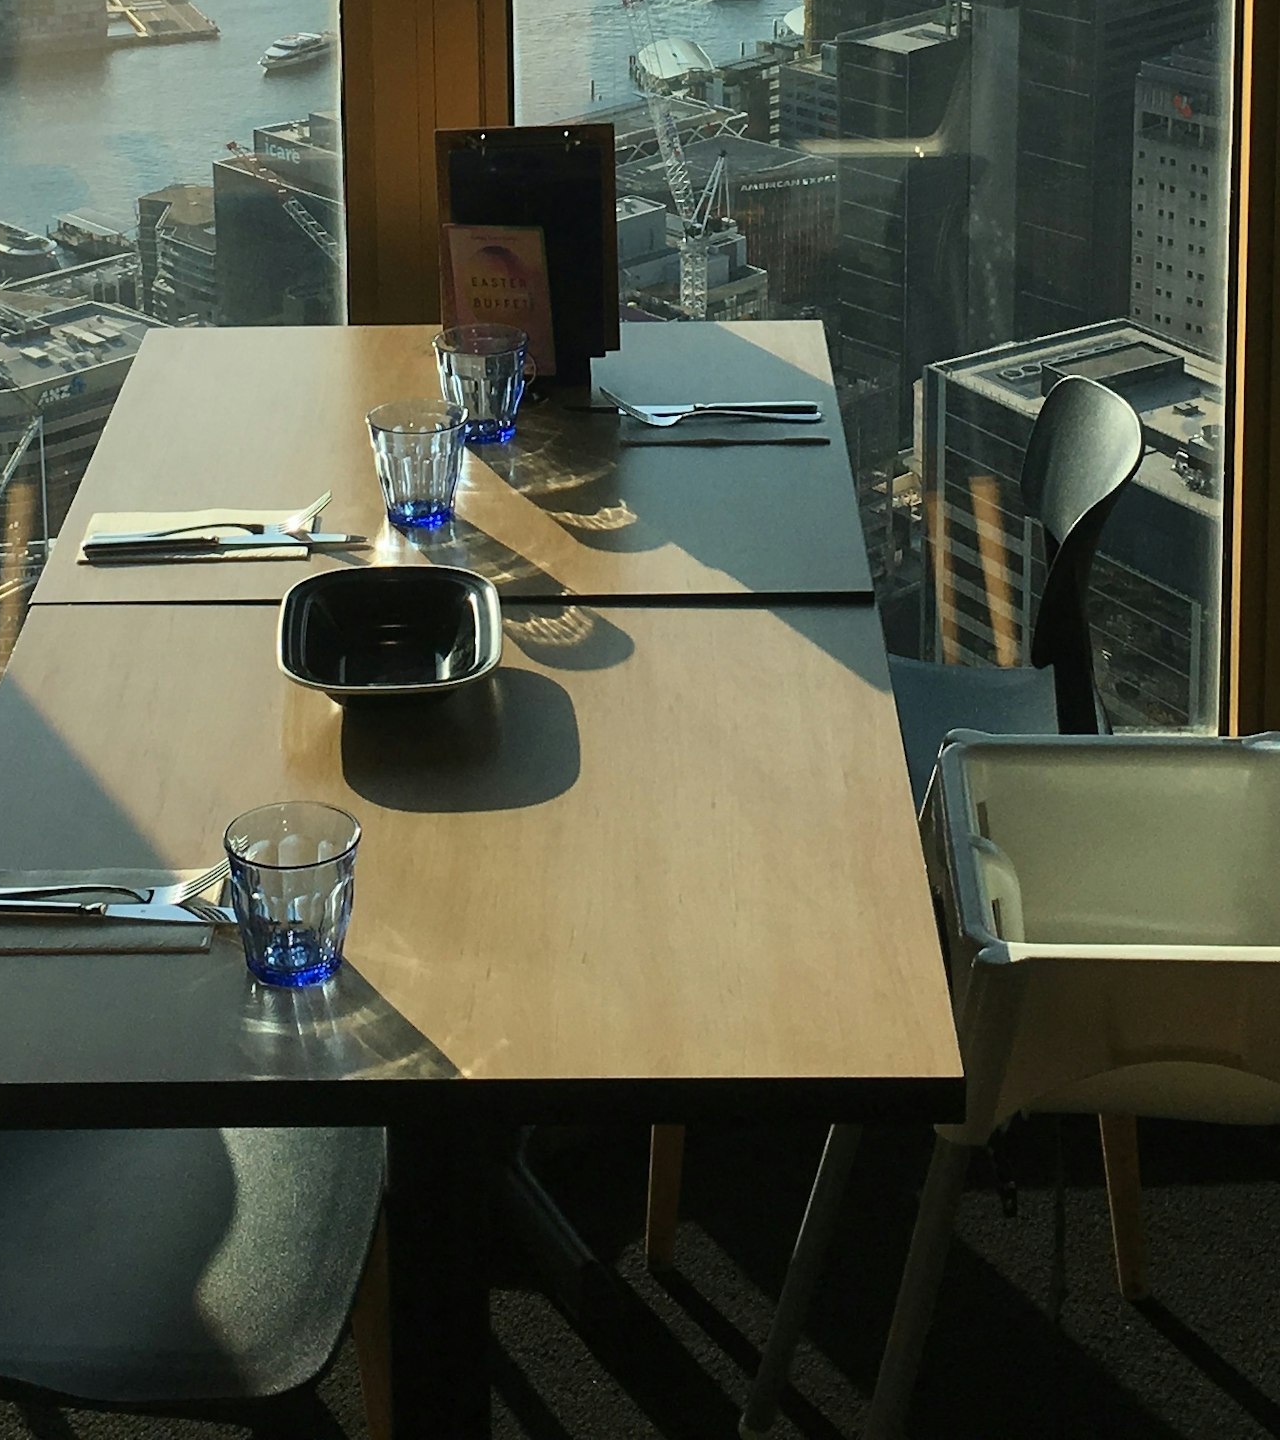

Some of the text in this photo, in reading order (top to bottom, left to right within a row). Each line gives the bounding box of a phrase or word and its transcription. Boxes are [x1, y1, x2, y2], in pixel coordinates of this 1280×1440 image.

[264, 136, 301, 165] icare
[740, 174, 837, 192] AMERICAN EXPRE
[471, 276, 527, 288] EASTER
[473, 297, 528, 309] BUFFET
[37, 384, 71, 406] ANZ
